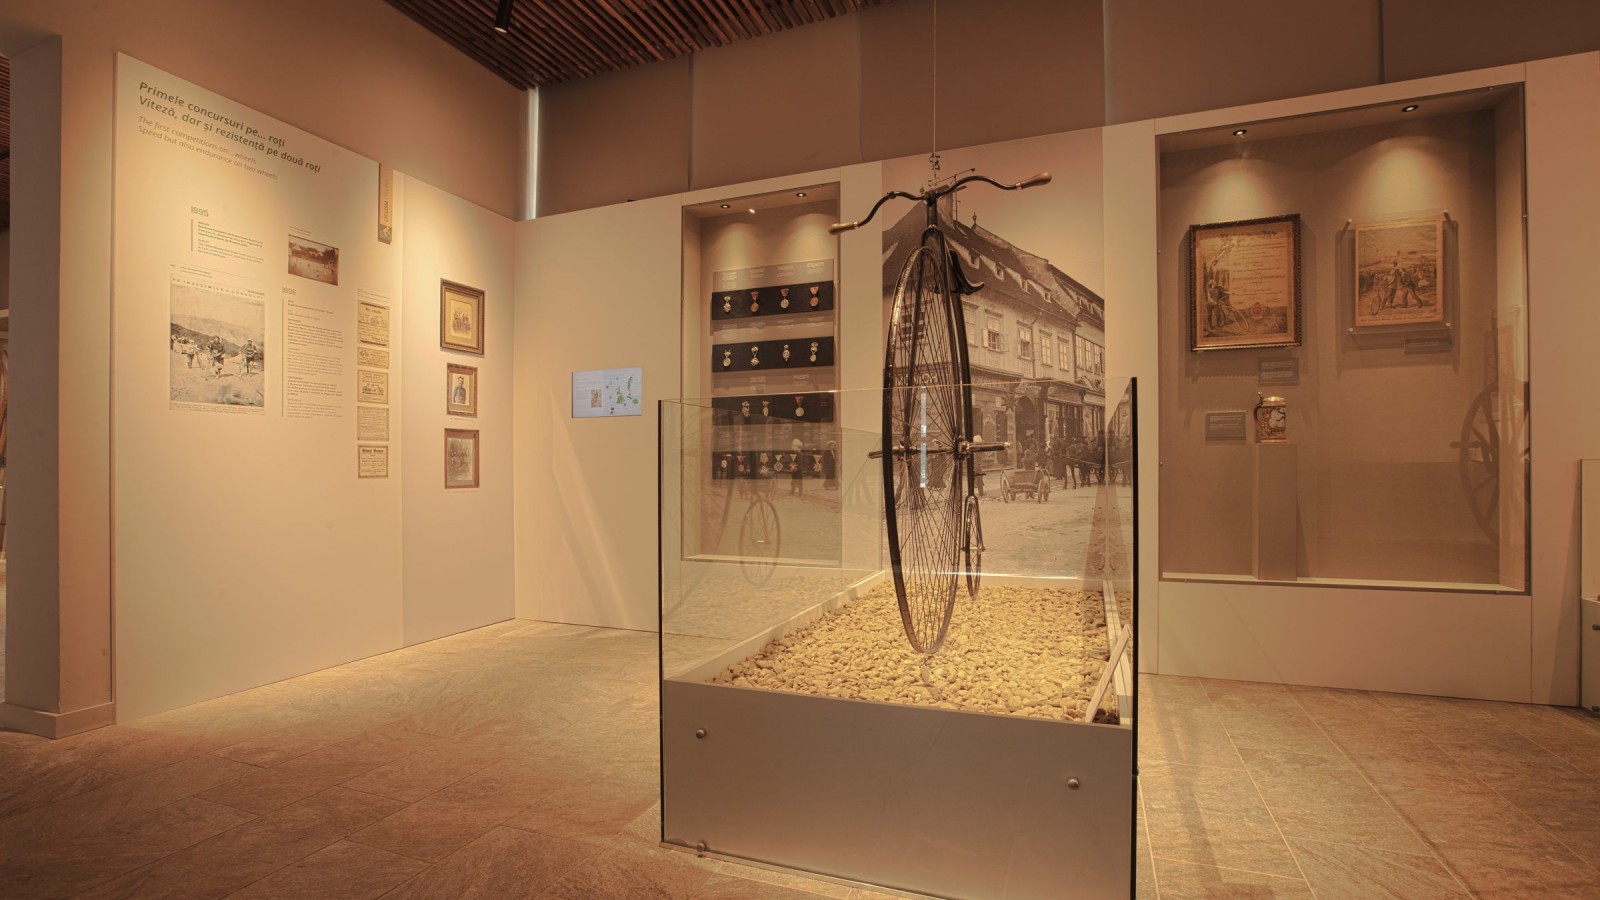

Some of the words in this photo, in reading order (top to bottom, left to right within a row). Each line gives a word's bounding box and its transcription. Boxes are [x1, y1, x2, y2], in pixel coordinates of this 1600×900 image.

[138, 116, 153, 126] The
[154, 120, 170, 132] first
[171, 128, 217, 151] competitions
[139, 81, 184, 107] Primele
[188, 102, 244, 131] concursuri
[246, 125, 266, 140] pe...
[269, 134, 285, 147] roți
[140, 96, 178, 119] Viteză,
[182, 113, 201, 127] dar
[203, 121, 212, 131] și
[216, 127, 265, 151] rezistență
[267, 146, 278, 157] pe
[281, 151, 303, 166] două
[305, 162, 321, 173] roți
[138, 125, 162, 139] Speed
[164, 134, 177, 144] but
[179, 140, 194, 151] also
[196, 145, 232, 164] endurance
[244, 163, 255, 172] two
